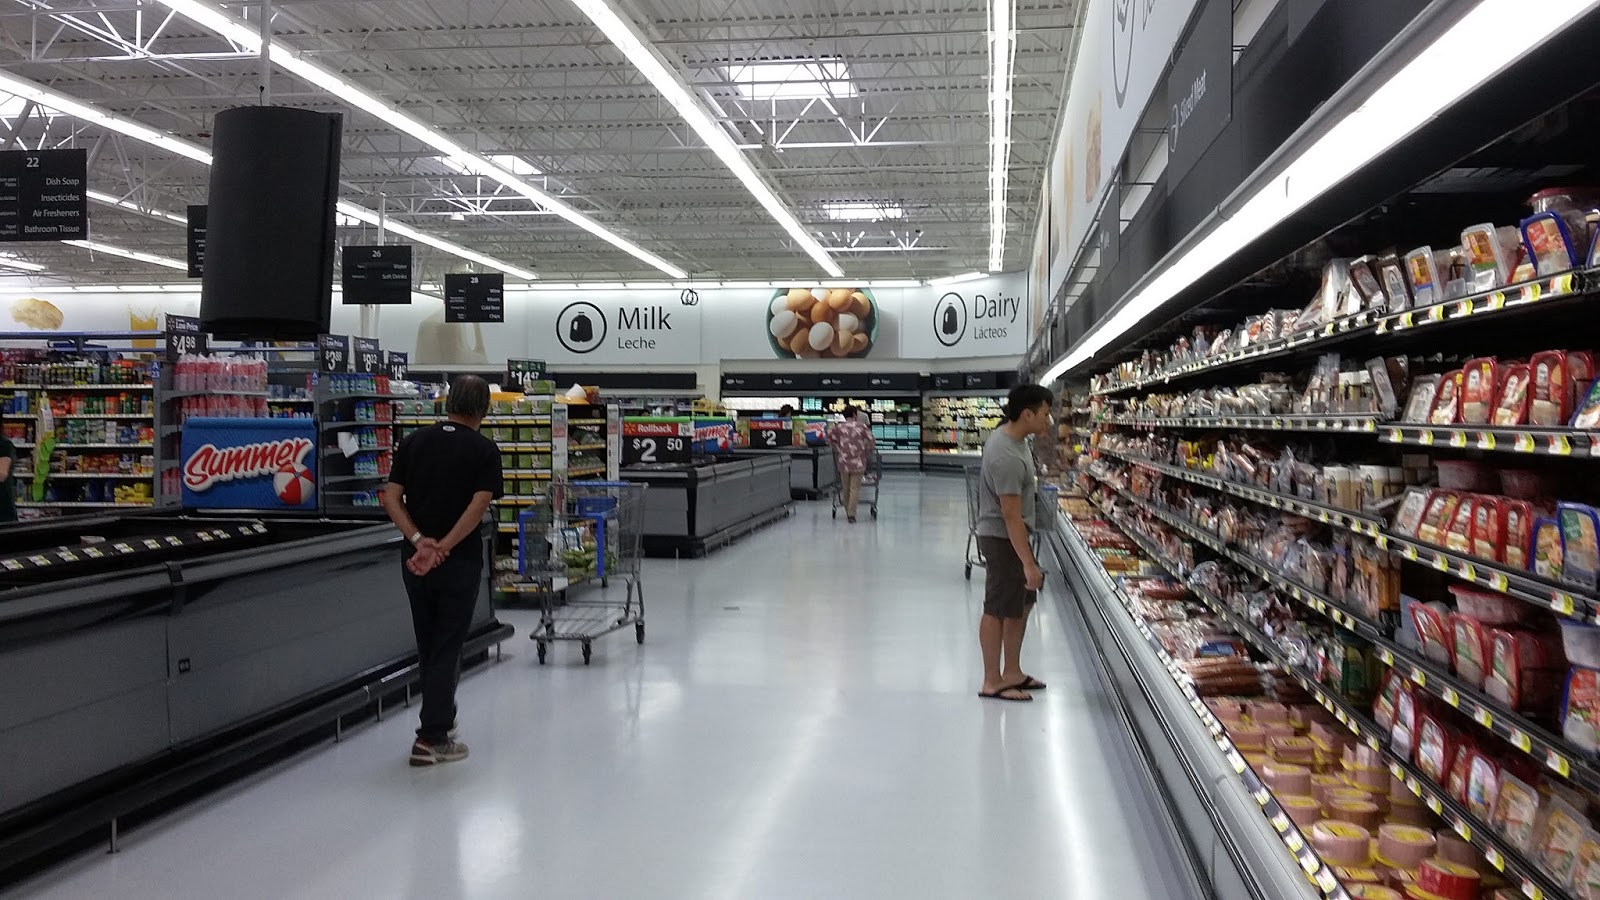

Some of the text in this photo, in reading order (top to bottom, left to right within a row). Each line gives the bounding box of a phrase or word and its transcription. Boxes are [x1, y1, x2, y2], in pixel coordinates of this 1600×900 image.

[1181, 69, 1206, 127] Sliced Meat
[26, 157, 40, 168] 22
[45, 177, 80, 187] Dish Soap
[40, 193, 80, 202] Insecticides
[32, 209, 80, 218] Air Fresheners
[24, 225, 58, 233] Bathroom
[58, 225, 80, 233] Tissue
[372, 250, 382, 258] 26
[470, 276, 479, 284] 28
[974, 292, 1020, 323] Dairy
[618, 306, 672, 330] Milk
[175, 319, 186, 330] Low
[186, 321, 199, 331] Price
[974, 326, 1008, 340] Lácteos
[617, 336, 656, 349] Leche
[637, 423, 673, 434] Rollback
[761, 430, 777, 446] $2
[184, 438, 313, 491] Summer
